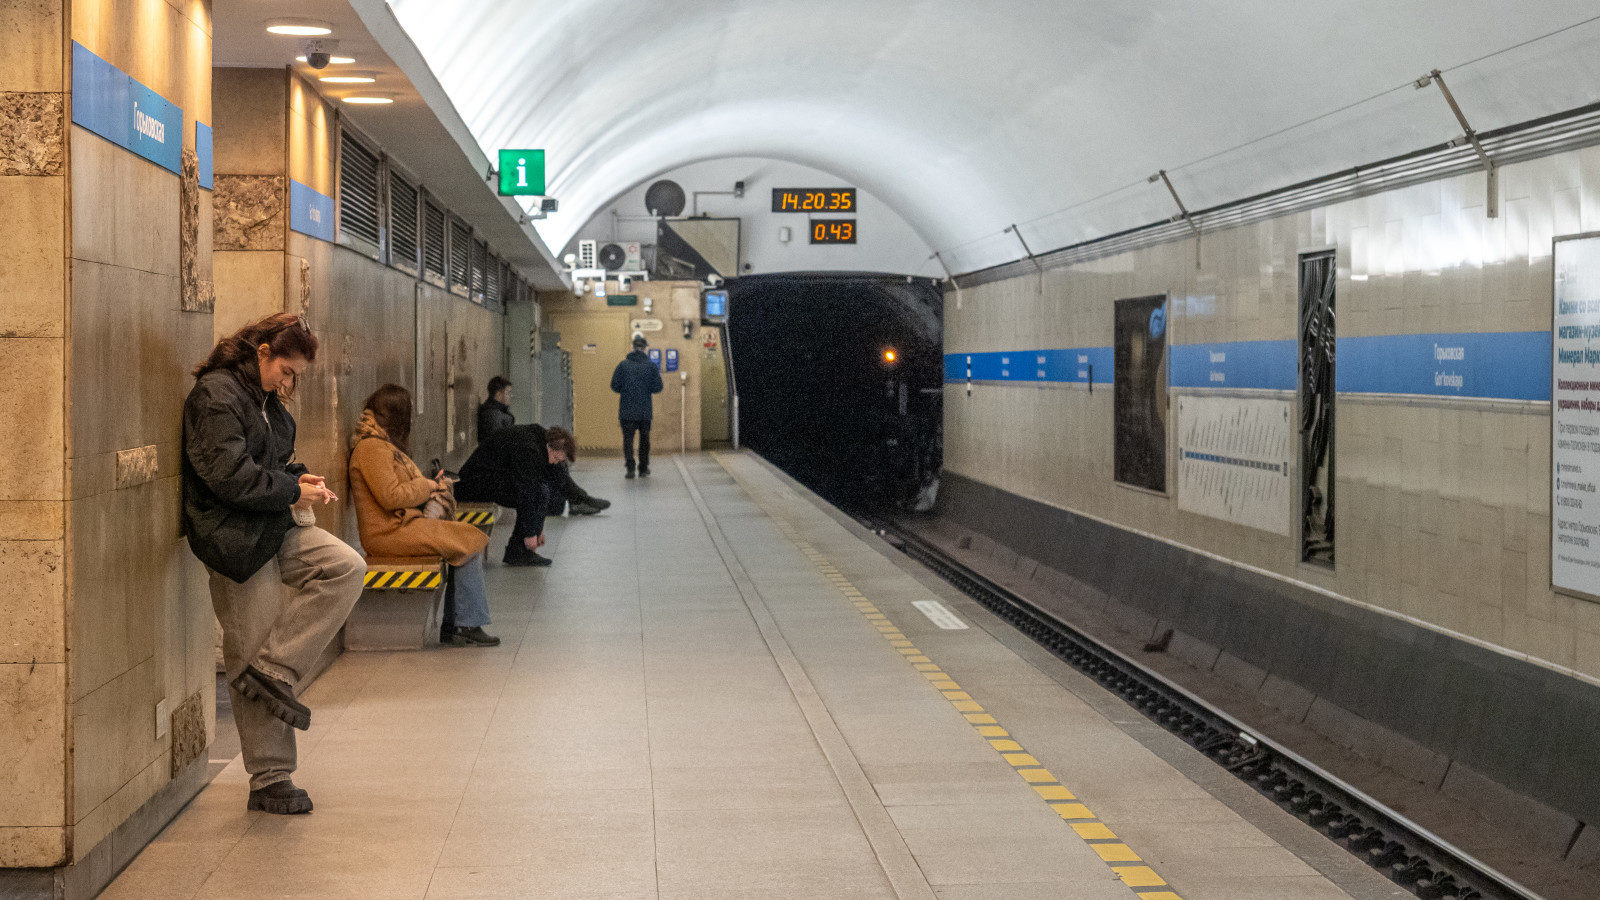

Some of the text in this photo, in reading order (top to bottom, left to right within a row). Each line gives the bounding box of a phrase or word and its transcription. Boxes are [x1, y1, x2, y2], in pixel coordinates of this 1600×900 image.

[134, 101, 165, 144] Горьковская
[516, 158, 528, 187] i
[781, 192, 852, 210] 14.20.35
[814, 223, 852, 240] 0.43
